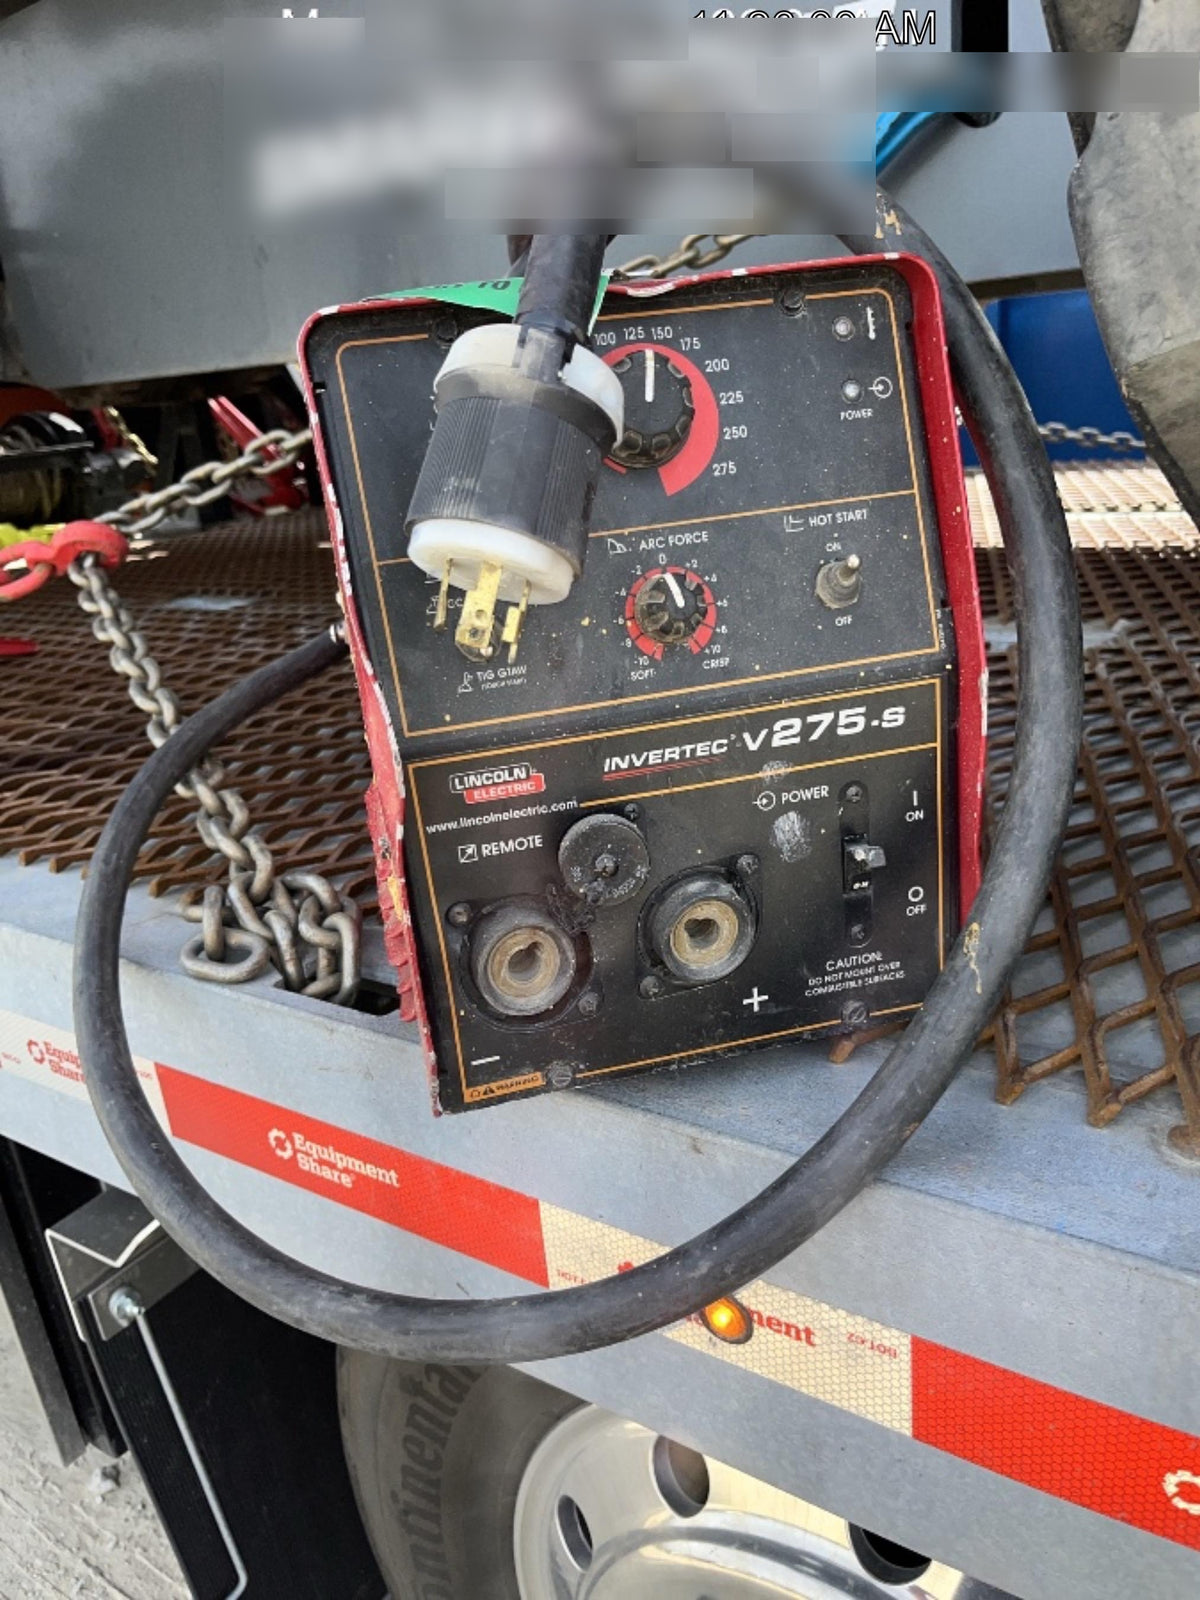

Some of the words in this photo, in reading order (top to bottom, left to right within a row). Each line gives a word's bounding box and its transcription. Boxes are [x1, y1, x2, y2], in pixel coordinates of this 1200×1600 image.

[594, 332, 616, 346] 100
[623, 326, 645, 340] 125
[651, 326, 673, 340] 150
[680, 337, 701, 351] 175
[704, 358, 730, 373] 200
[719, 390, 744, 405] 225
[840, 408, 873, 421] POWER
[723, 426, 748, 440] 250
[712, 461, 737, 476] 275
[808, 513, 832, 527] HOT
[835, 508, 867, 523] START
[639, 535, 665, 550] ARC
[668, 530, 709, 546] FORCE
[825, 542, 842, 552] ON
[835, 615, 852, 626] OFF
[476, 669, 495, 682] TIG
[630, 668, 655, 681] SOFT
[603, 738, 729, 773] INVERTEC
[454, 766, 527, 791] LINCOLN
[473, 781, 537, 800] ELECTRIC
[781, 785, 830, 804] POWER
[425, 801, 579, 835] www.lincolnelectric.com
[905, 809, 924, 822] ON
[481, 834, 544, 858] REMOTE
[906, 904, 927, 917] OFF
[292, 1132, 400, 1188] Equipment
[296, 1152, 353, 1188] Share
